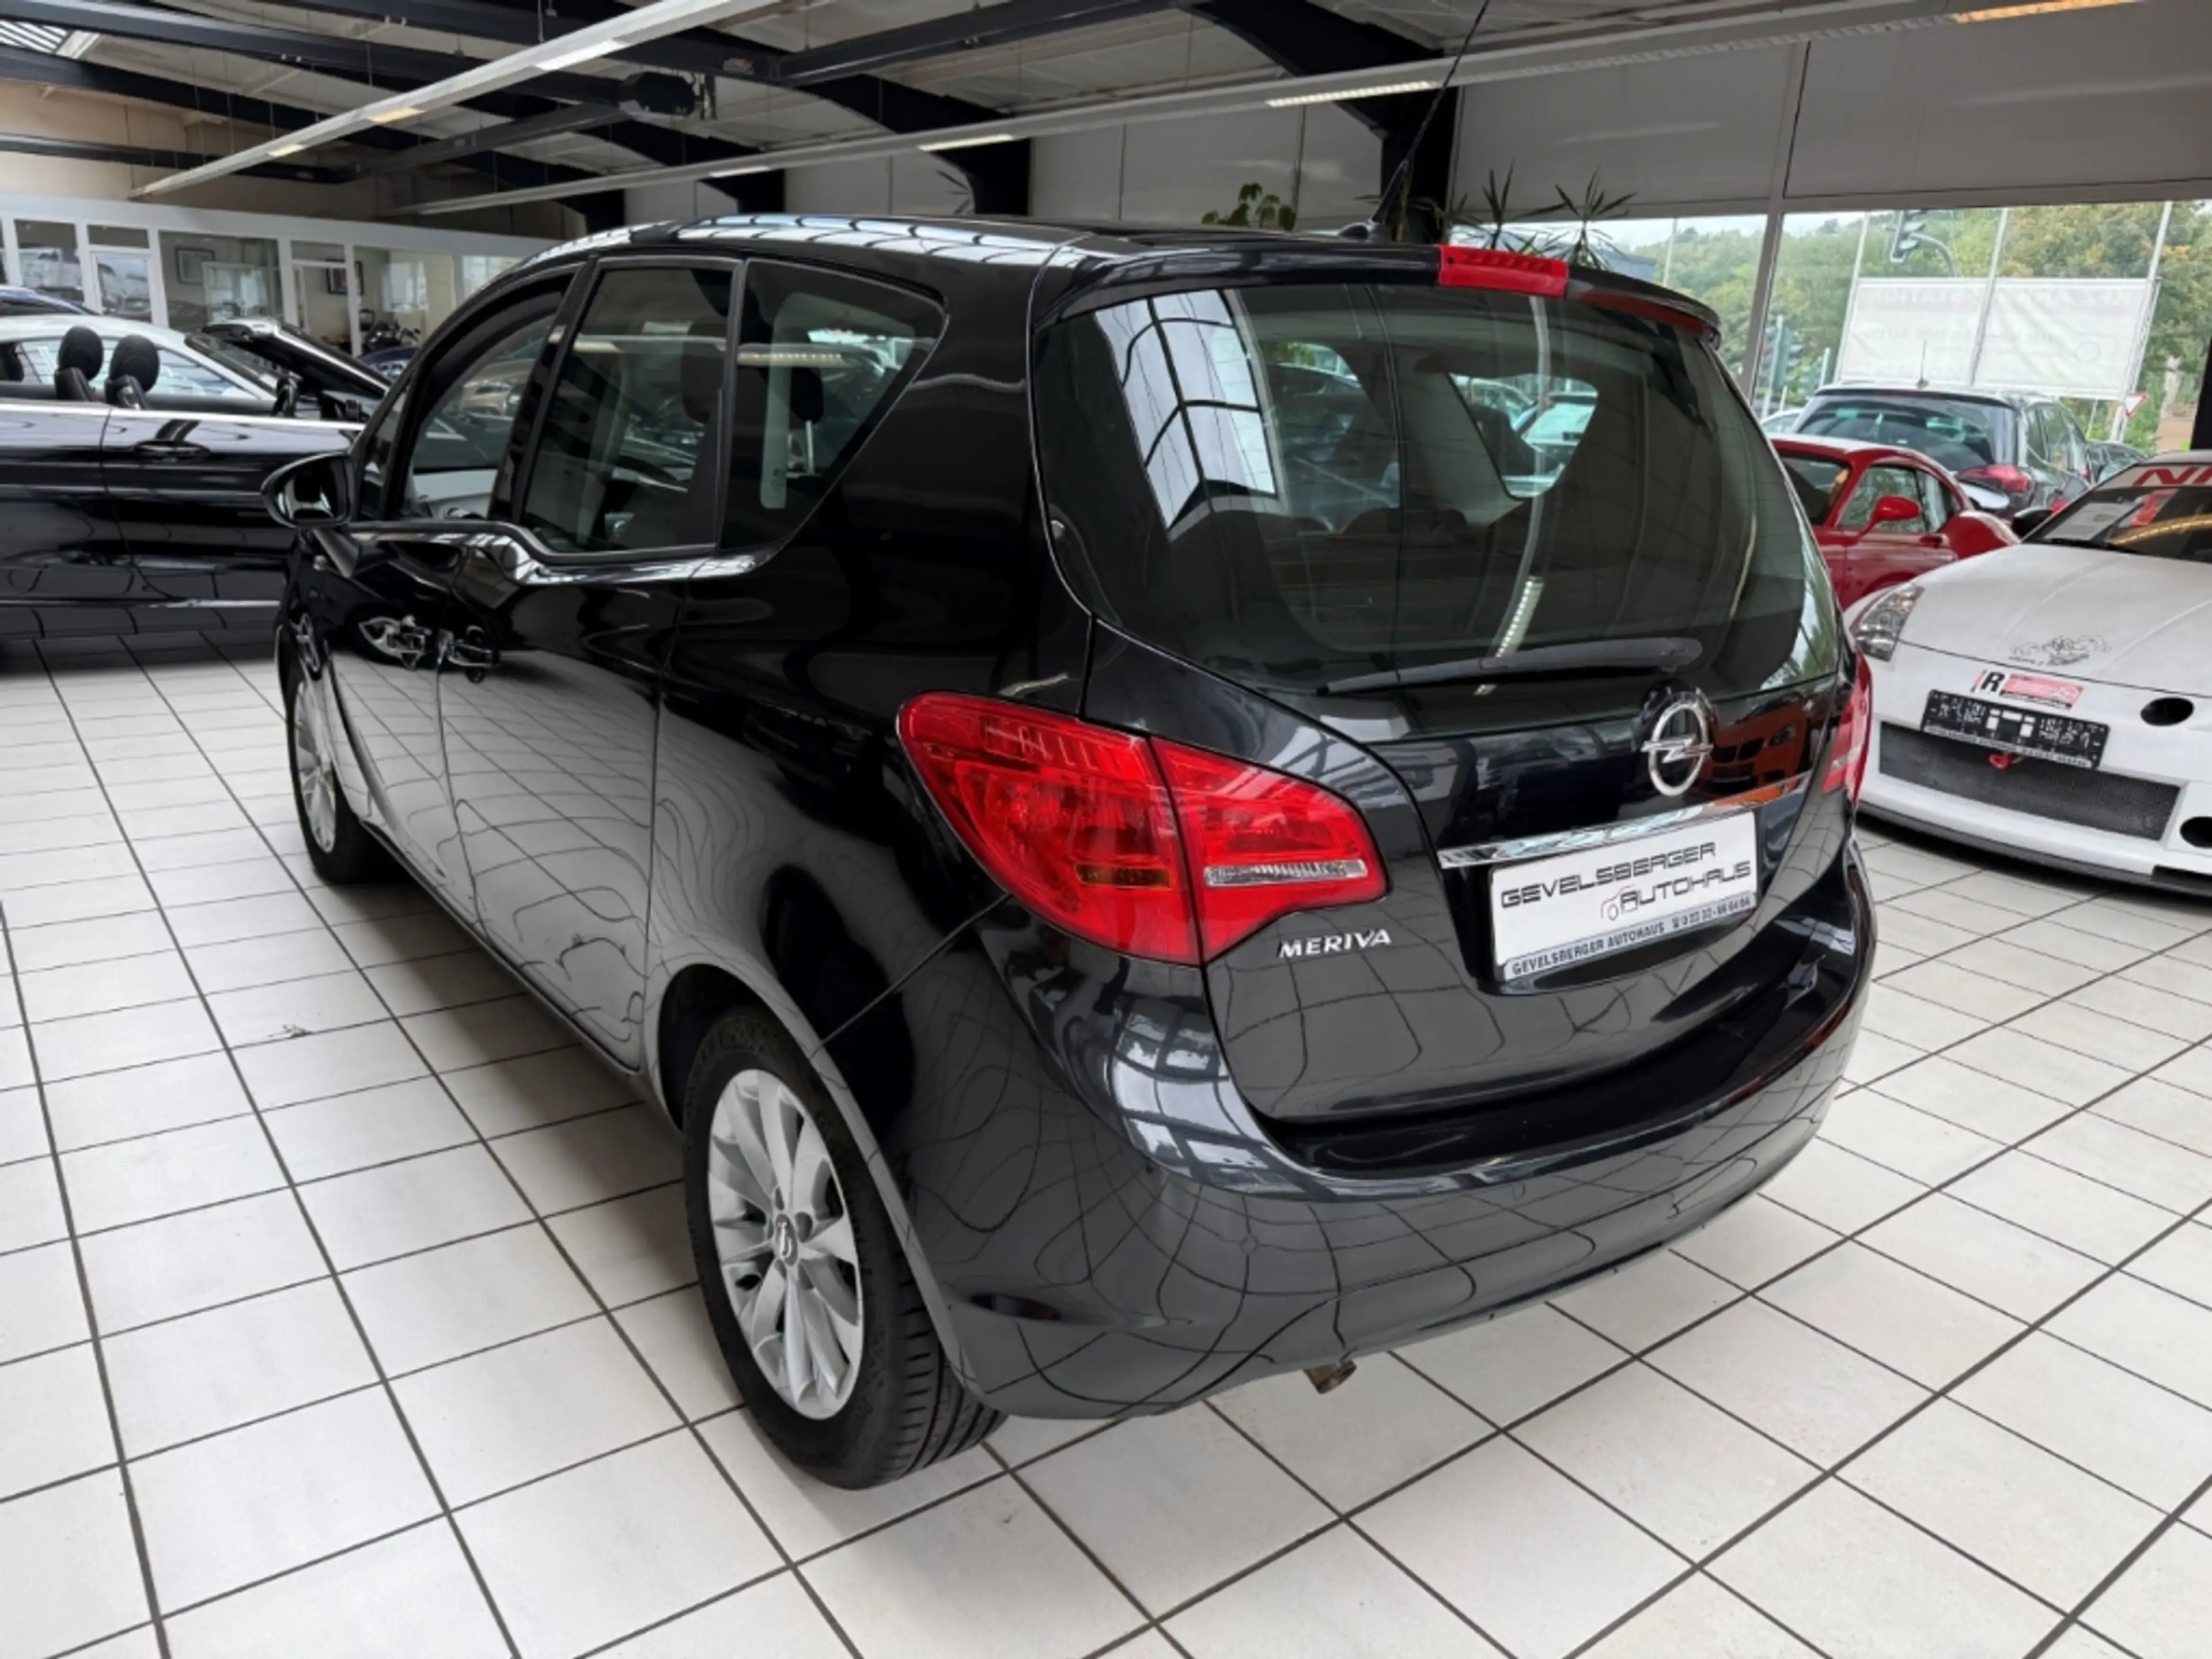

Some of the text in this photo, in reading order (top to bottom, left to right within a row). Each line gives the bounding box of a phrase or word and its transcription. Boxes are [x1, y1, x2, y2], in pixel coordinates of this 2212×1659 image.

[1501, 842, 1716, 909] GEVELSBERGER
[1619, 860, 1751, 912] AUTOHAUS
[1278, 928, 1392, 958] MERIVA
[1512, 938, 1604, 975] GEVELSBERGER
[1607, 921, 1665, 948] AUTOHAUS
